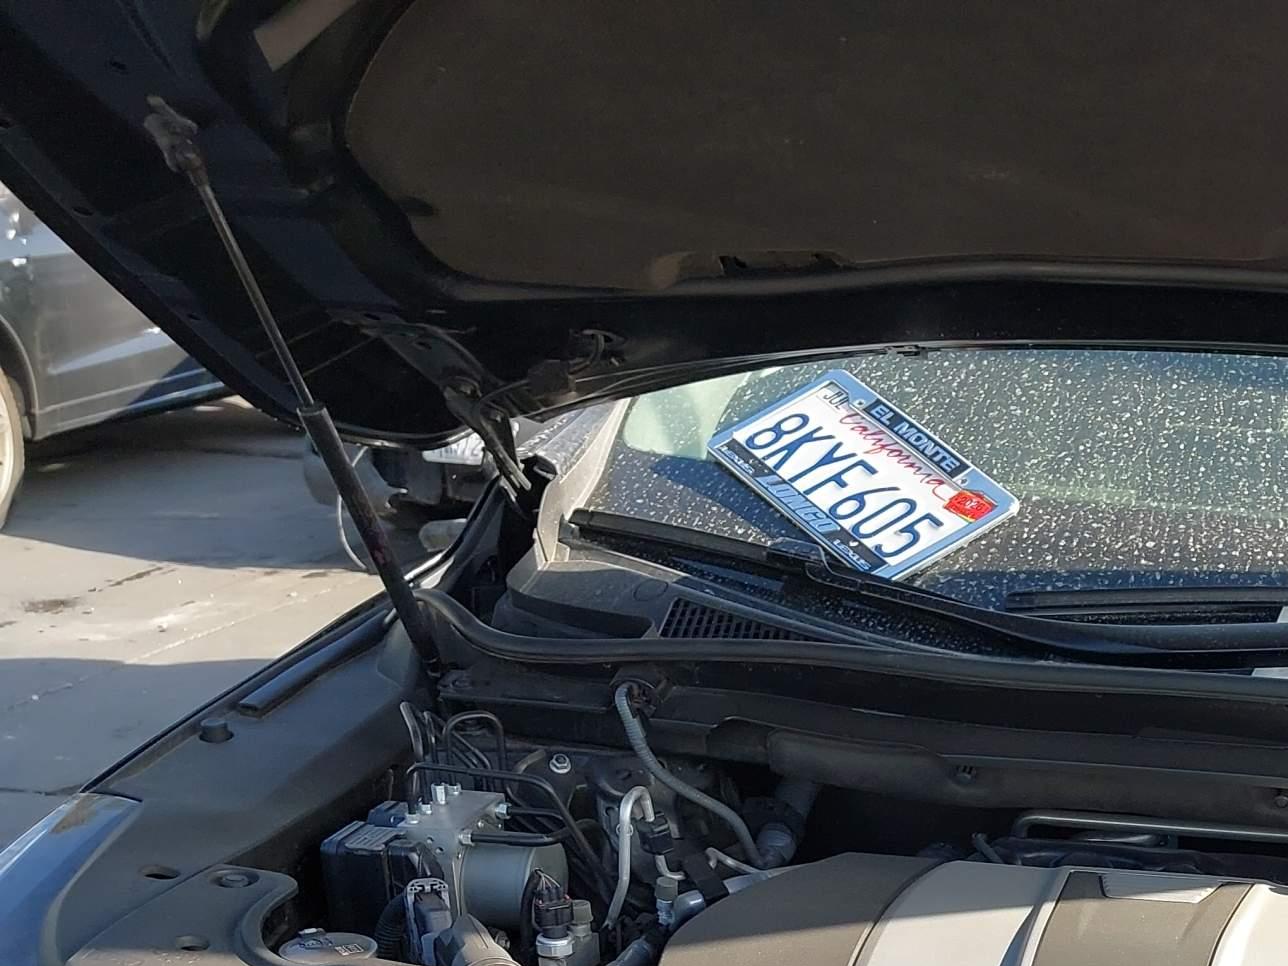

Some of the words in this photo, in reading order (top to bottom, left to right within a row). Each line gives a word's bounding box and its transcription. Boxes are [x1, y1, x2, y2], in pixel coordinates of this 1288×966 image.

[823, 389, 848, 411] JUL
[839, 409, 948, 501] California
[870, 405, 892, 426] EL
[893, 421, 961, 473] MONTE
[745, 412, 944, 558] 8KYF605
[832, 539, 871, 571] LEXUS
